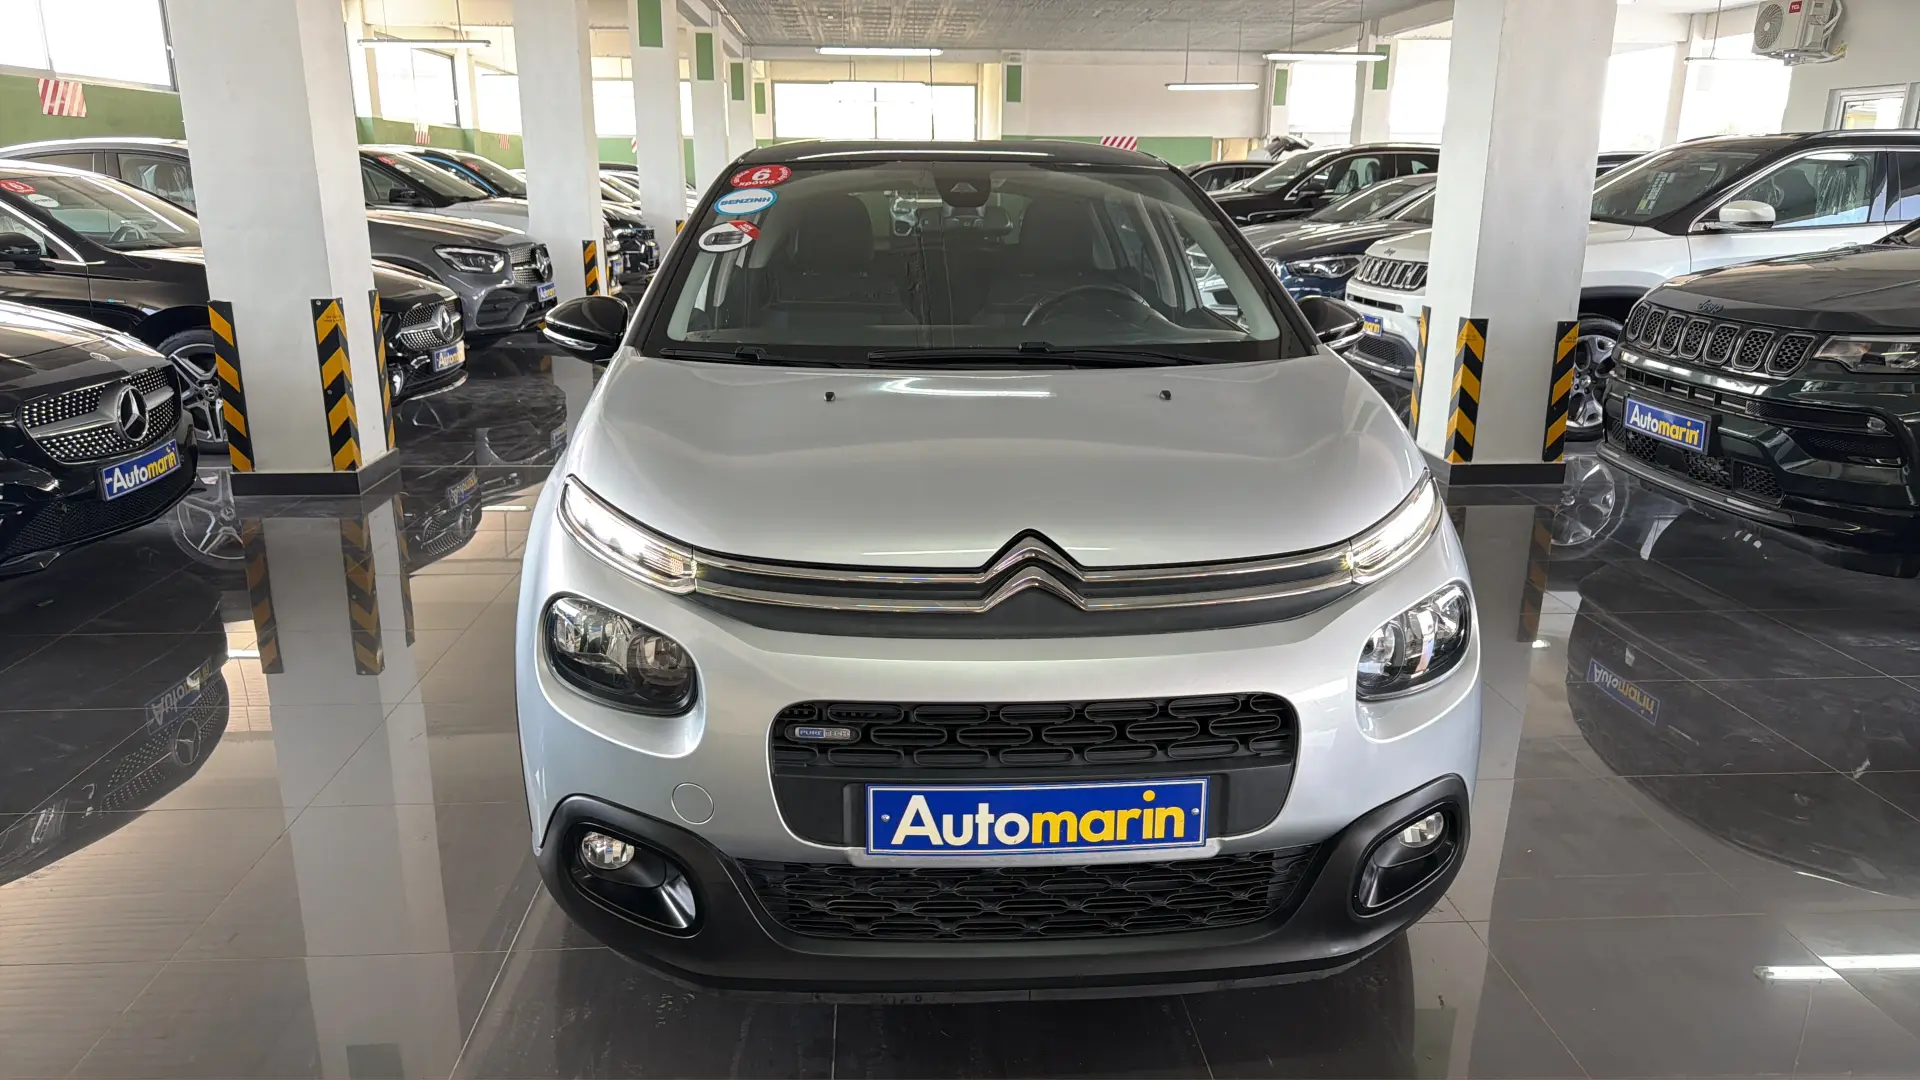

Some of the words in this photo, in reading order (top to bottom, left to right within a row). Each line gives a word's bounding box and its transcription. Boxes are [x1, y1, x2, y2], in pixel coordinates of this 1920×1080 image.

[752, 170, 771, 181] 6
[1697, 300, 1724, 314] Jeep
[1629, 404, 1699, 446] Automarin
[113, 446, 177, 494] Automarin
[891, 789, 1185, 846] Automarin
